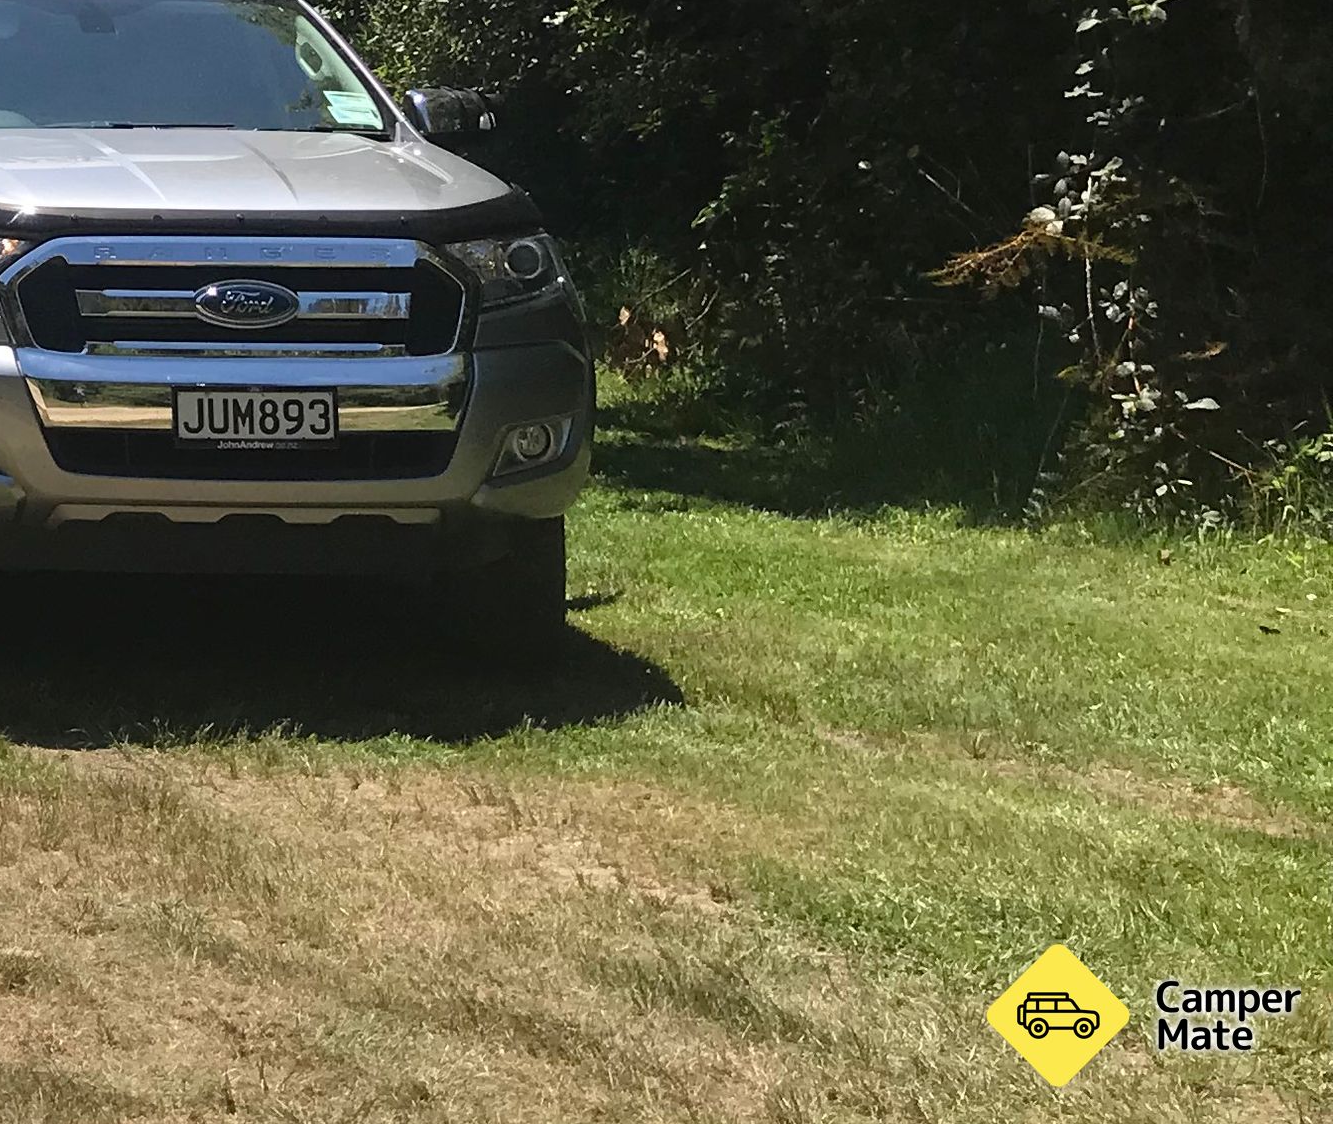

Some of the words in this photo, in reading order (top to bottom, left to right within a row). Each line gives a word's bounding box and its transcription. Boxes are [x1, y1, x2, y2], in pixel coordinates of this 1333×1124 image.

[93, 245, 391, 260] RANGER
[220, 290, 274, 315] Ford
[183, 398, 331, 436] JUM893
